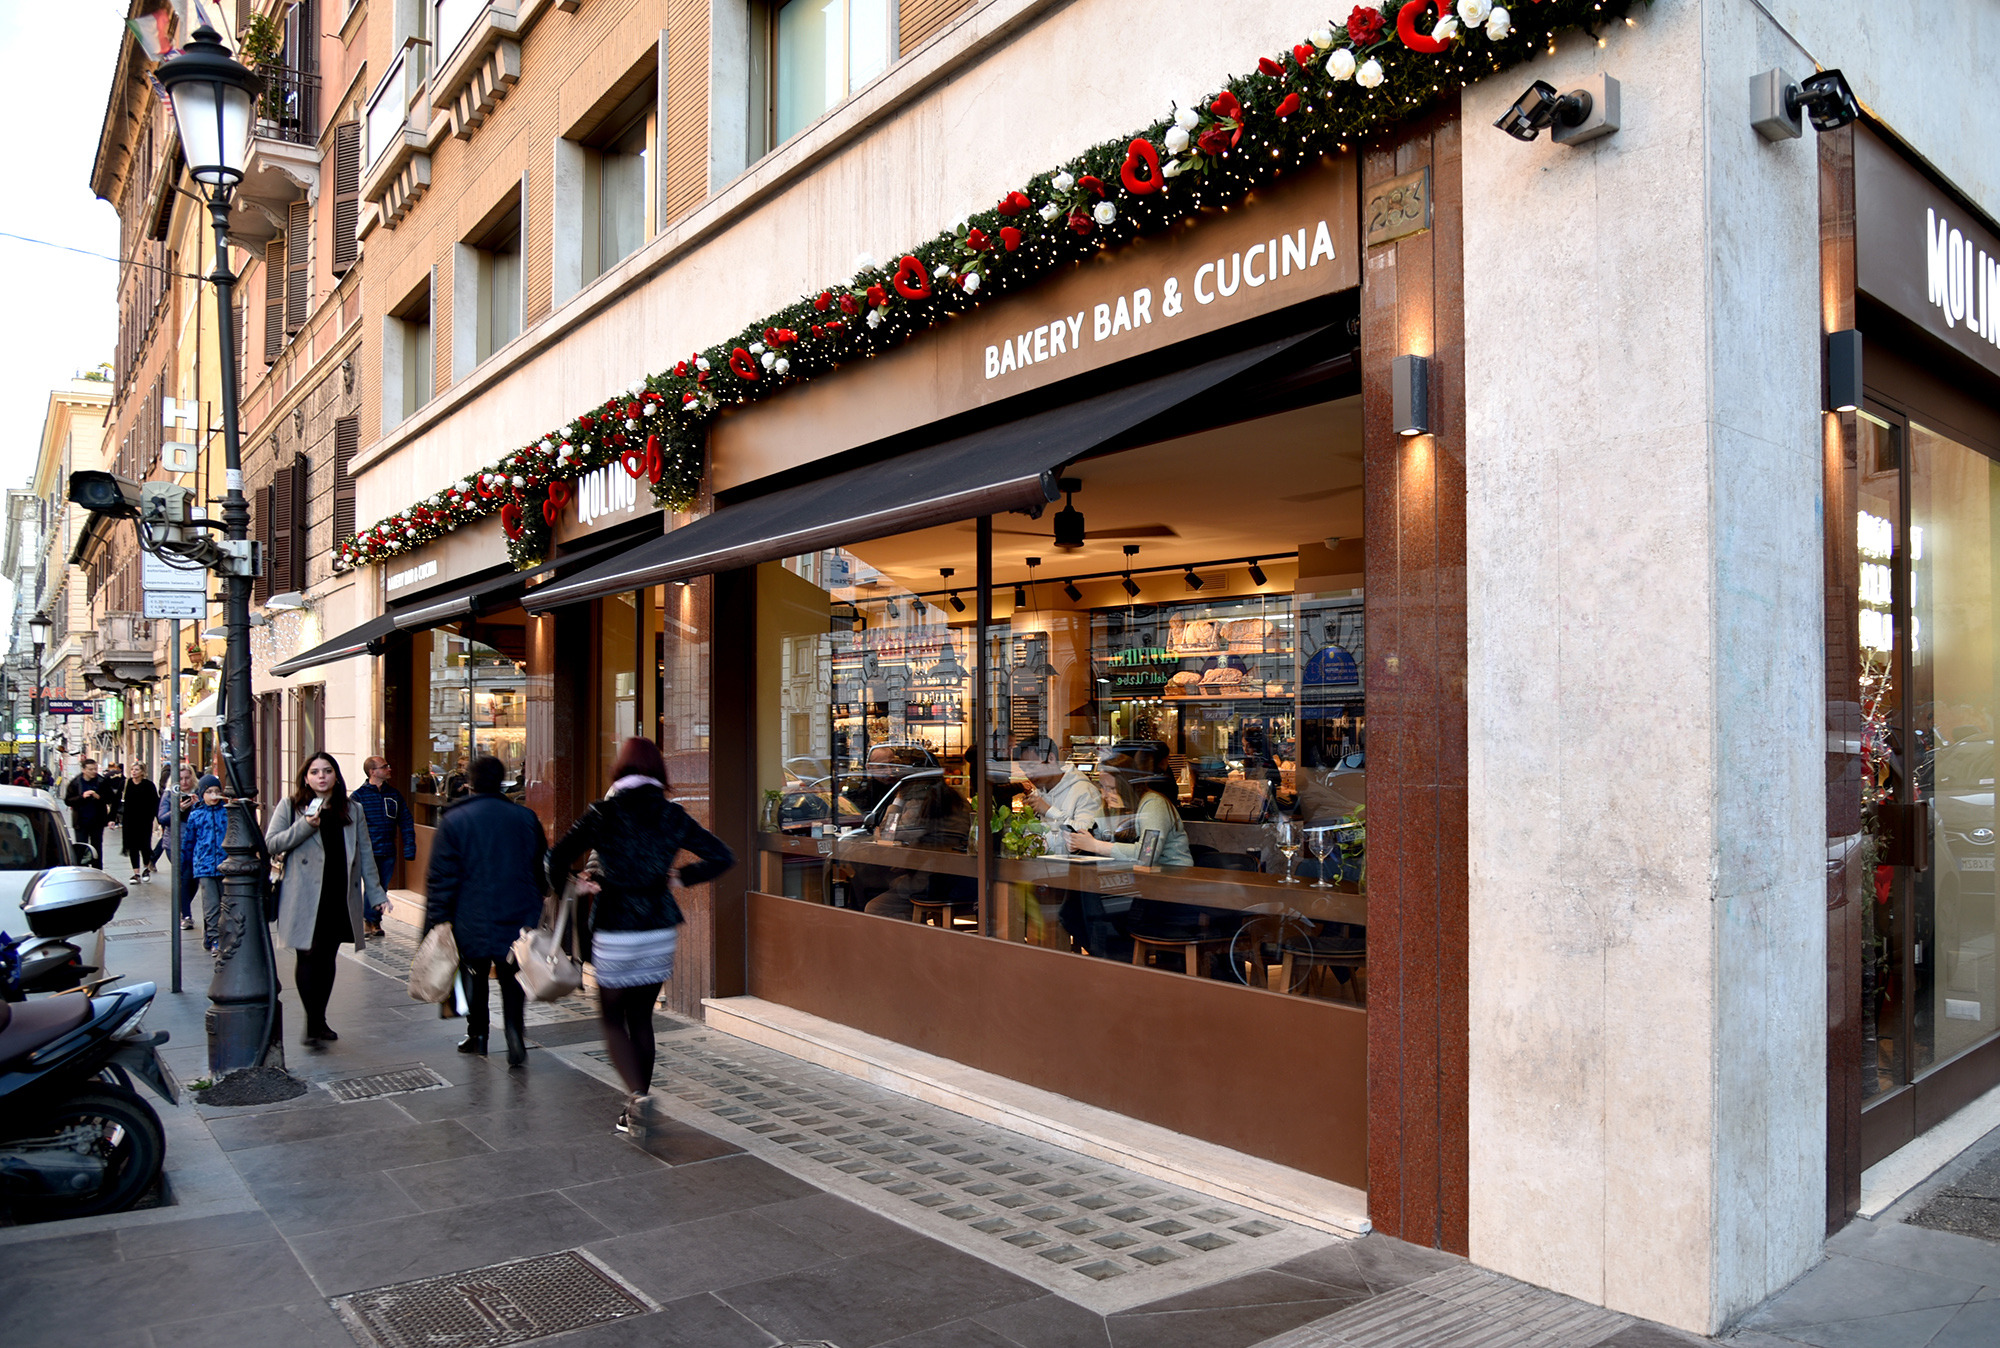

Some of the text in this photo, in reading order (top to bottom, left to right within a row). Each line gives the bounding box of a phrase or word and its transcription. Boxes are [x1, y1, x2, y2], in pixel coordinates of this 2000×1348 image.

[1368, 180, 1421, 233] 283
[985, 220, 1336, 380] BAKERY BAR & CUCINA
[578, 456, 637, 526] MOLINO
[29, 687, 67, 698] BAR
